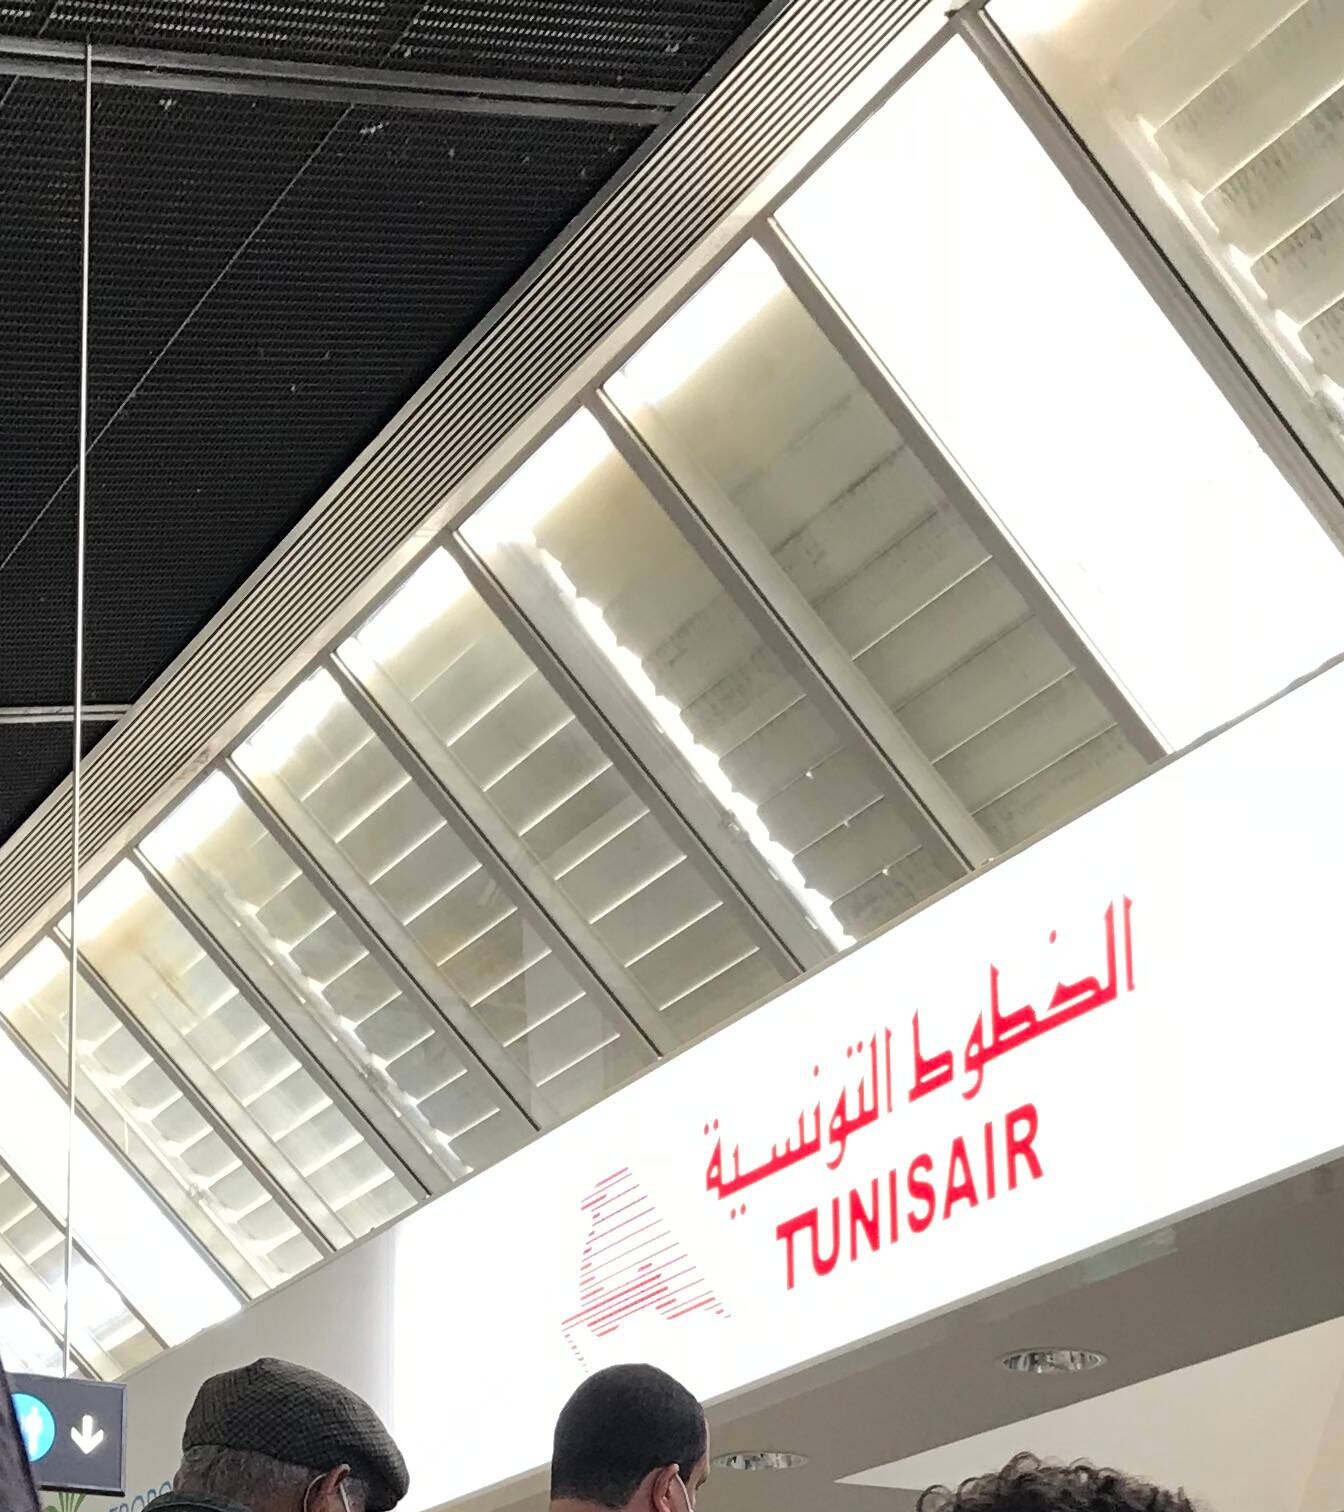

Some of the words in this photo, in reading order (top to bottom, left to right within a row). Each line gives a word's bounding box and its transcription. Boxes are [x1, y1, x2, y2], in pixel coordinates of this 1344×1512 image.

[908, 895, 1134, 1102] الخطوط
[704, 1026, 892, 1219] التونسية
[776, 1103, 1043, 1290] TUNISAIR
